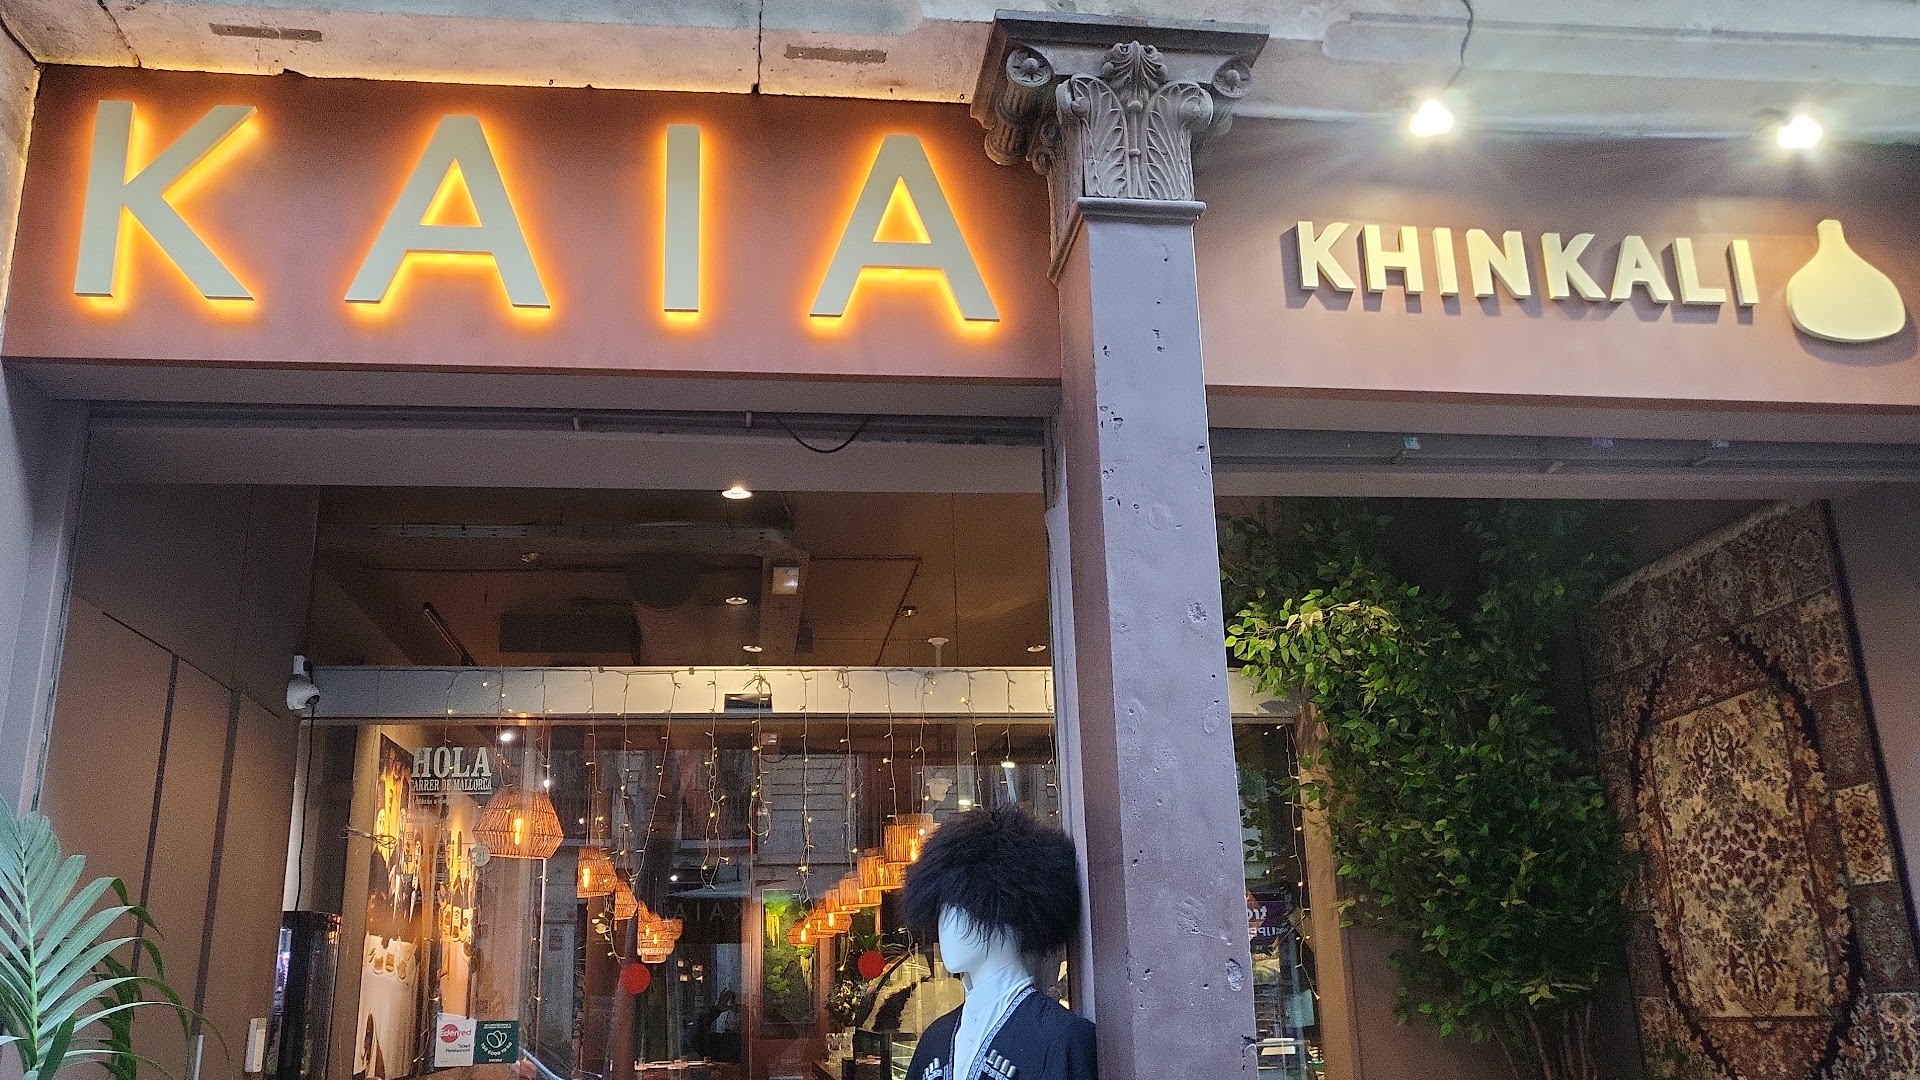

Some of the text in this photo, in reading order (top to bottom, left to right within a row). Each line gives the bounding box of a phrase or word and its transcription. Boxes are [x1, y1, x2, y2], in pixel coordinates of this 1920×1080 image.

[74, 100, 999, 323] KAIA
[1296, 220, 1759, 307] KHINKALI
[411, 746, 492, 778] HOLA
[442, 779, 452, 791] DE
[453, 778, 493, 791] MALLORCA
